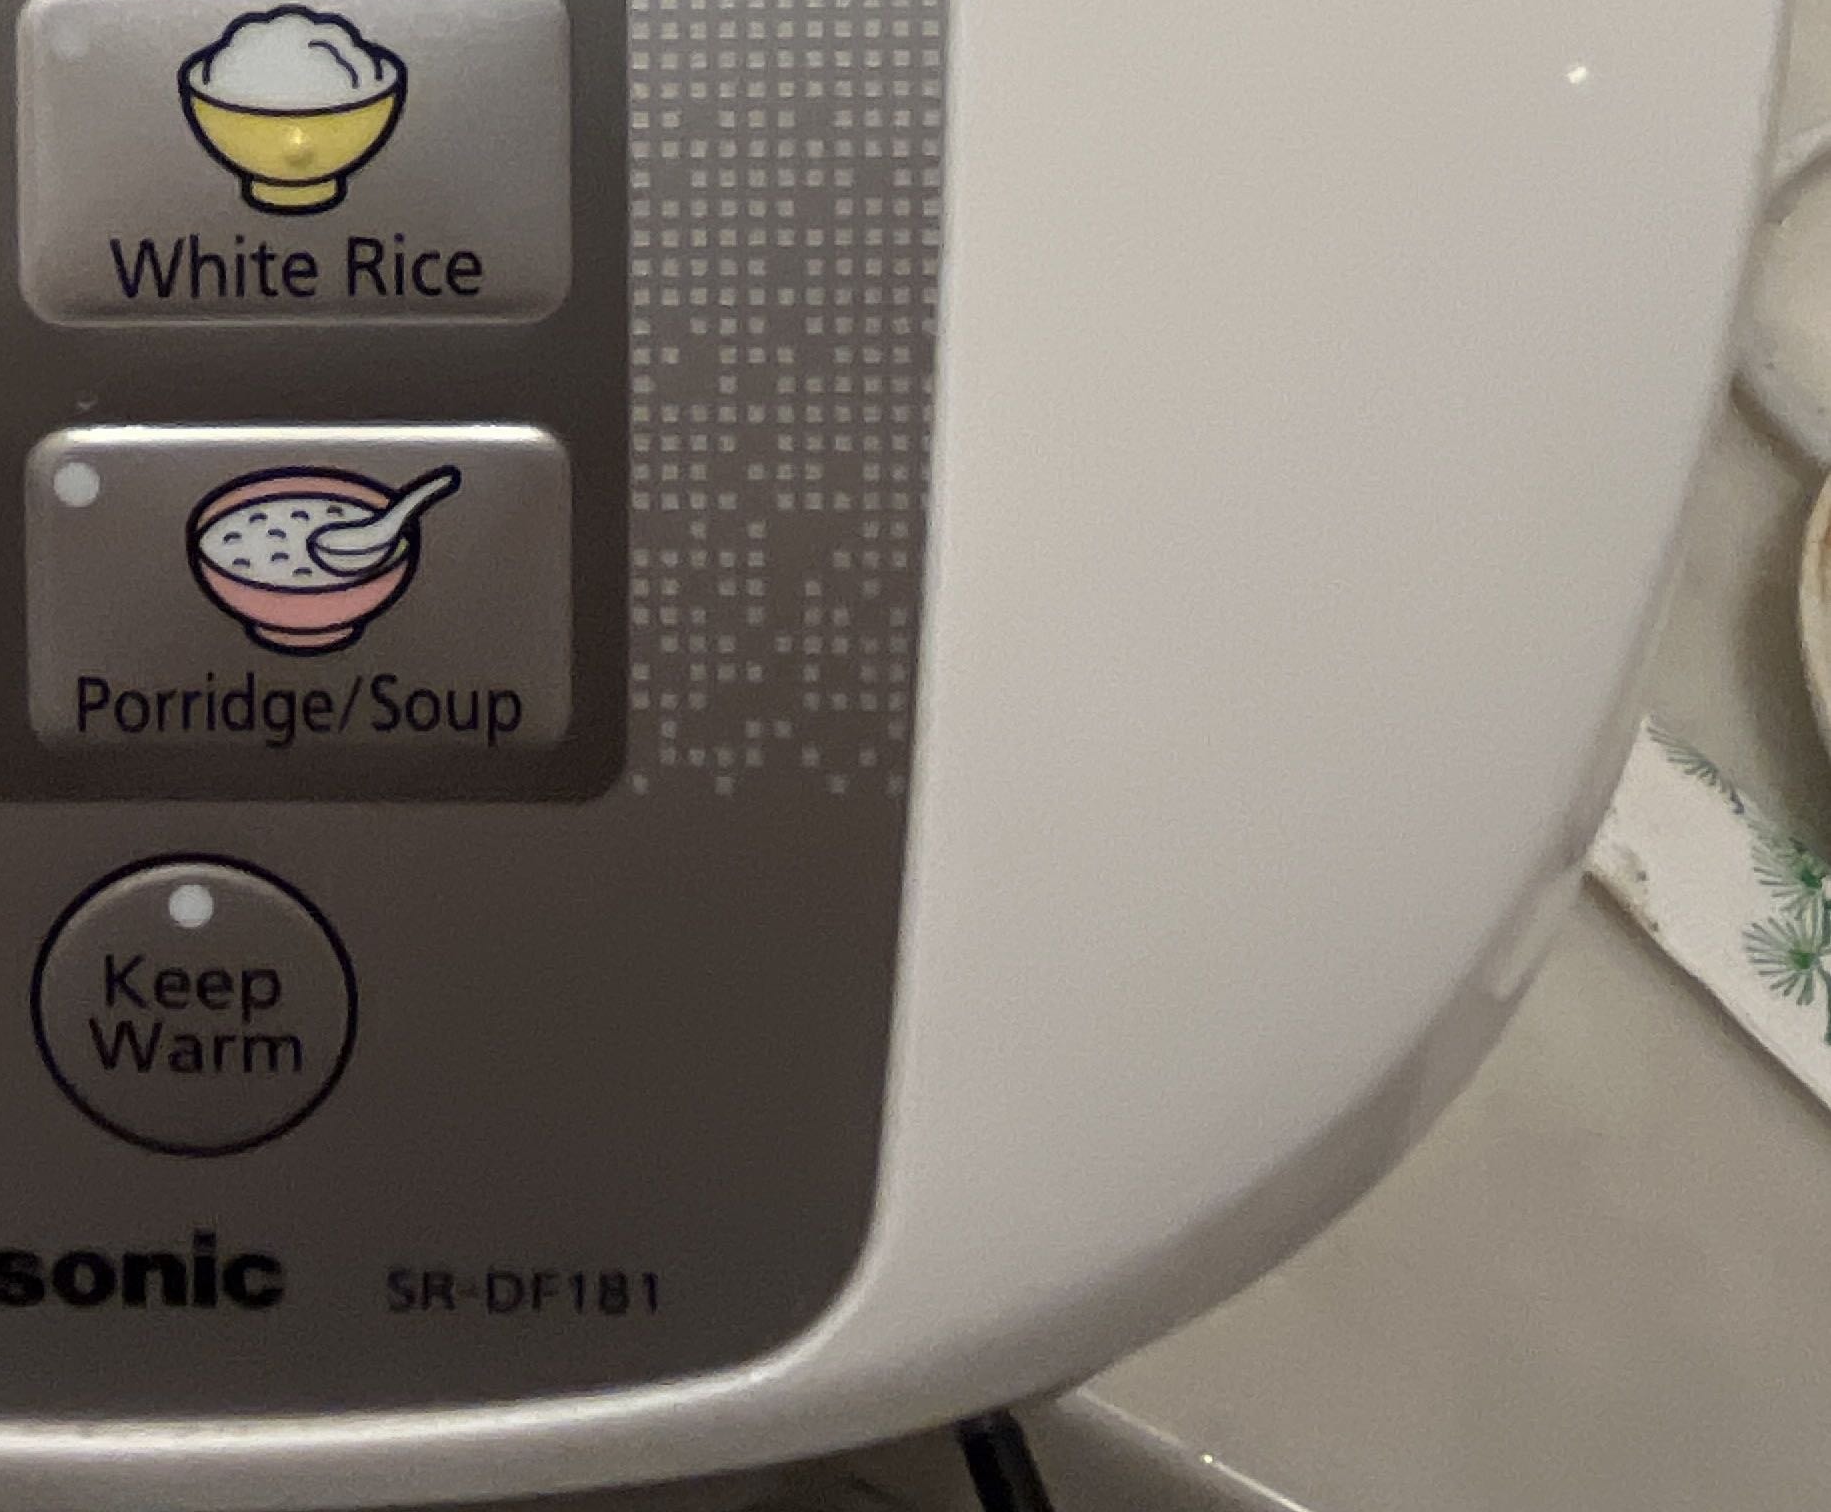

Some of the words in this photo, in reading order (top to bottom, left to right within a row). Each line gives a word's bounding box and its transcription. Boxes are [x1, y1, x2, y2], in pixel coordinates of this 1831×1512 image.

[109, 232, 319, 299] White
[347, 232, 483, 296] Rice
[76, 672, 523, 748] Porridge/Soup
[102, 953, 283, 1017] Keep
[87, 1016, 304, 1075] Warm
[384, 1267, 661, 1316] SR-DF181
